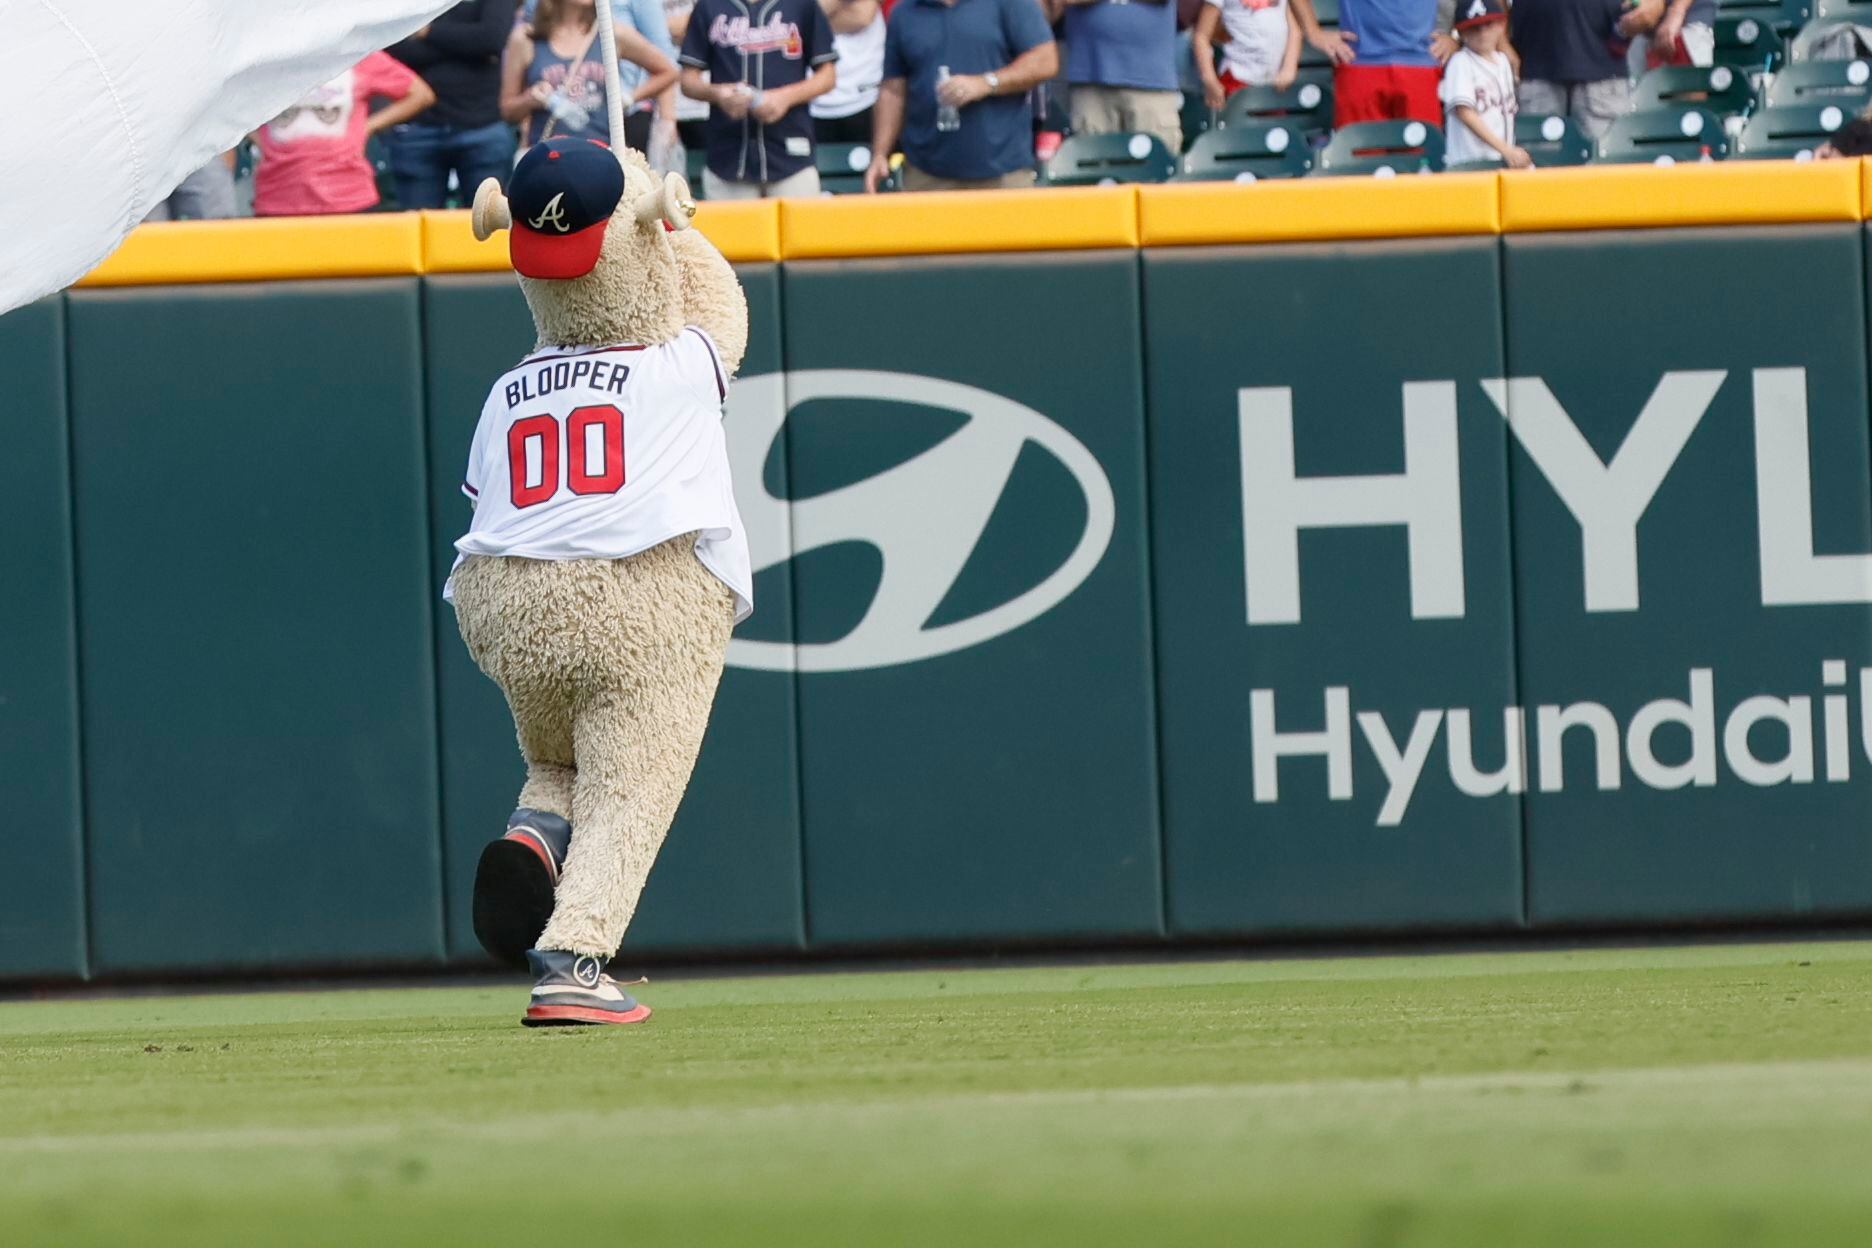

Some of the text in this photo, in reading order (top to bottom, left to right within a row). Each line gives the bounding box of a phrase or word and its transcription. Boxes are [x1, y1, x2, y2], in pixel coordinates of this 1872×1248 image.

[528, 191, 571, 233] A
[504, 359, 631, 410] BLOOPER
[506, 403, 626, 510] 00
[1237, 365, 1872, 626] HYL
[1249, 659, 1872, 827] Hyundai
